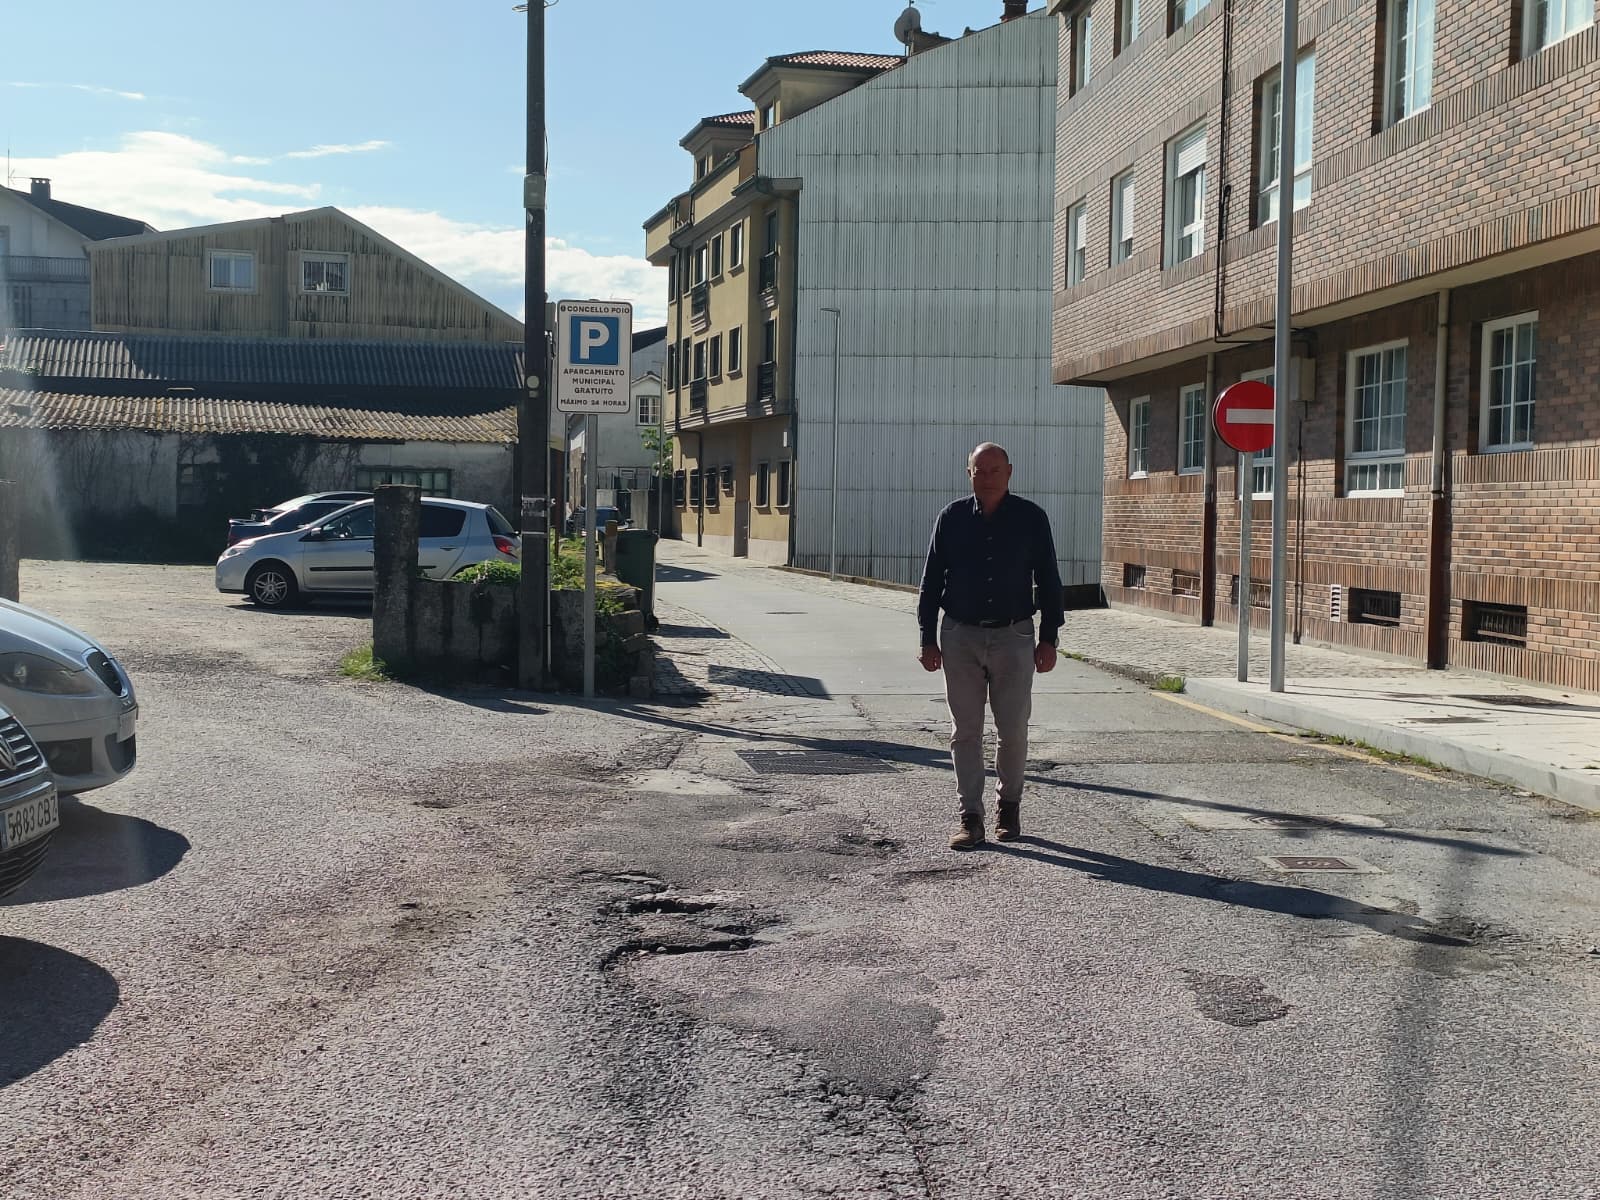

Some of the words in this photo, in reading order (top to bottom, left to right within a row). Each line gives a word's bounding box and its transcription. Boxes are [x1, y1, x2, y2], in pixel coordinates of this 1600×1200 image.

[567, 305, 610, 313] CONCELLO
[580, 321, 610, 360] P
[563, 368, 625, 376] APARCAMIENTO
[574, 387, 614, 395] GRATUITO
[560, 398, 588, 406] MÁXIMO
[37, 795, 57, 828] CBZ
